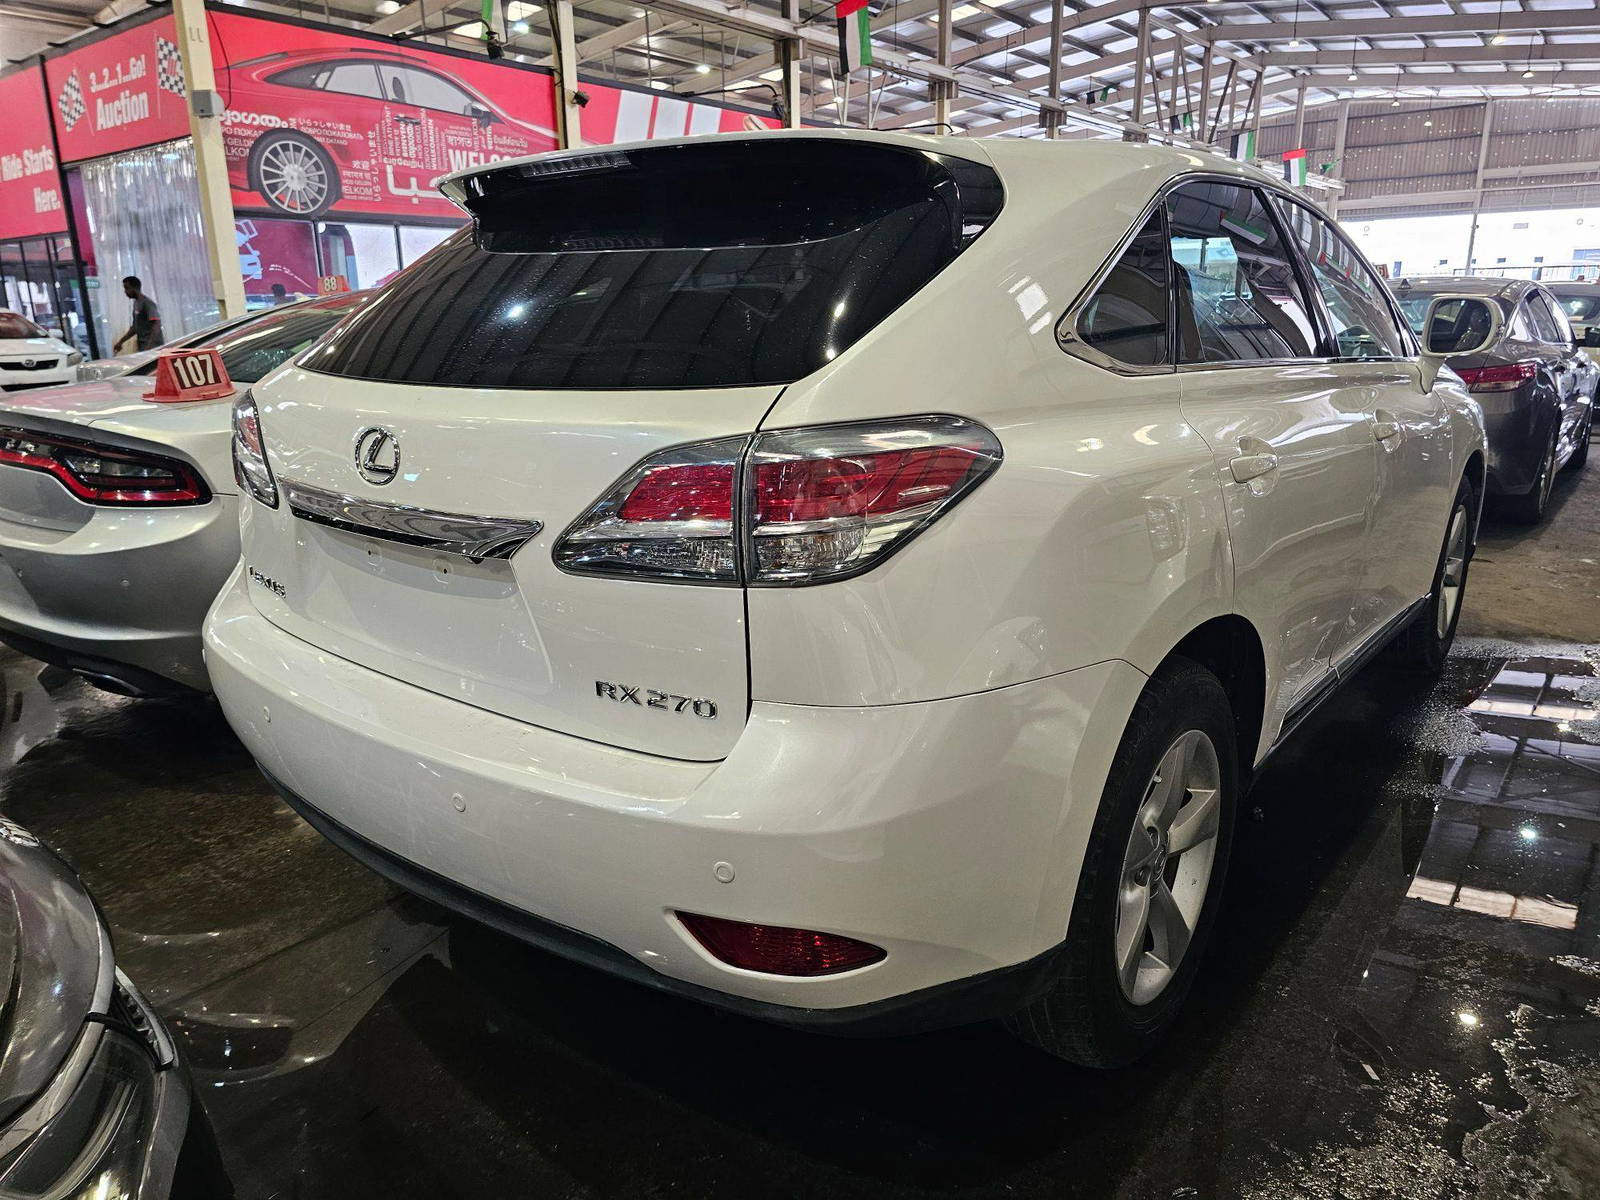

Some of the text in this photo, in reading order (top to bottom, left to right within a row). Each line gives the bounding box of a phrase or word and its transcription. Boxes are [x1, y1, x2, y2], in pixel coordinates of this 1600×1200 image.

[96, 89, 150, 131] Auction
[23, 145, 54, 176] Starts
[324, 276, 337, 292] 88
[174, 353, 215, 388] 107
[249, 565, 287, 600] LEXUS
[595, 680, 719, 720] RX 270
